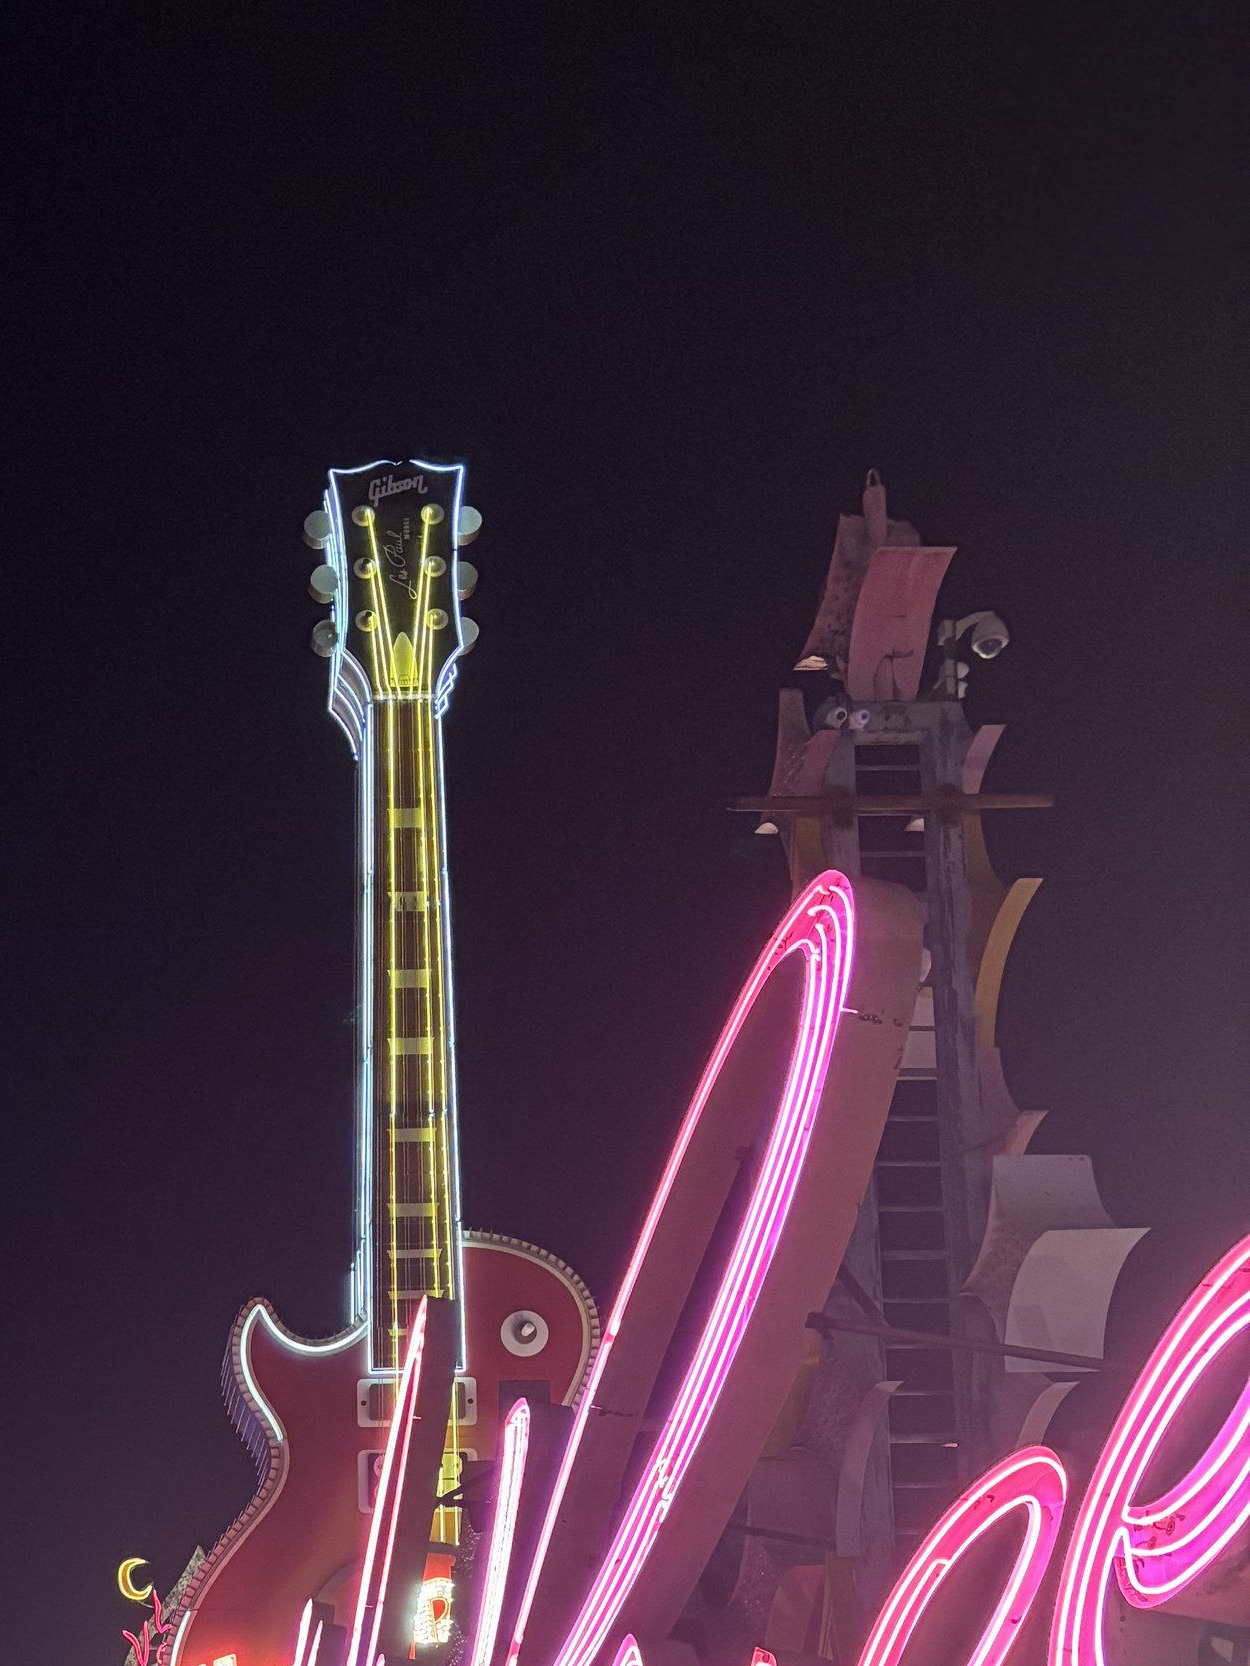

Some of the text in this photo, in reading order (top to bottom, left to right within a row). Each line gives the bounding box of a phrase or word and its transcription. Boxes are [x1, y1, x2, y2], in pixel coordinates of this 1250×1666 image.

[368, 474, 429, 507] Gibson
[382, 530, 418, 600] Les Paul
